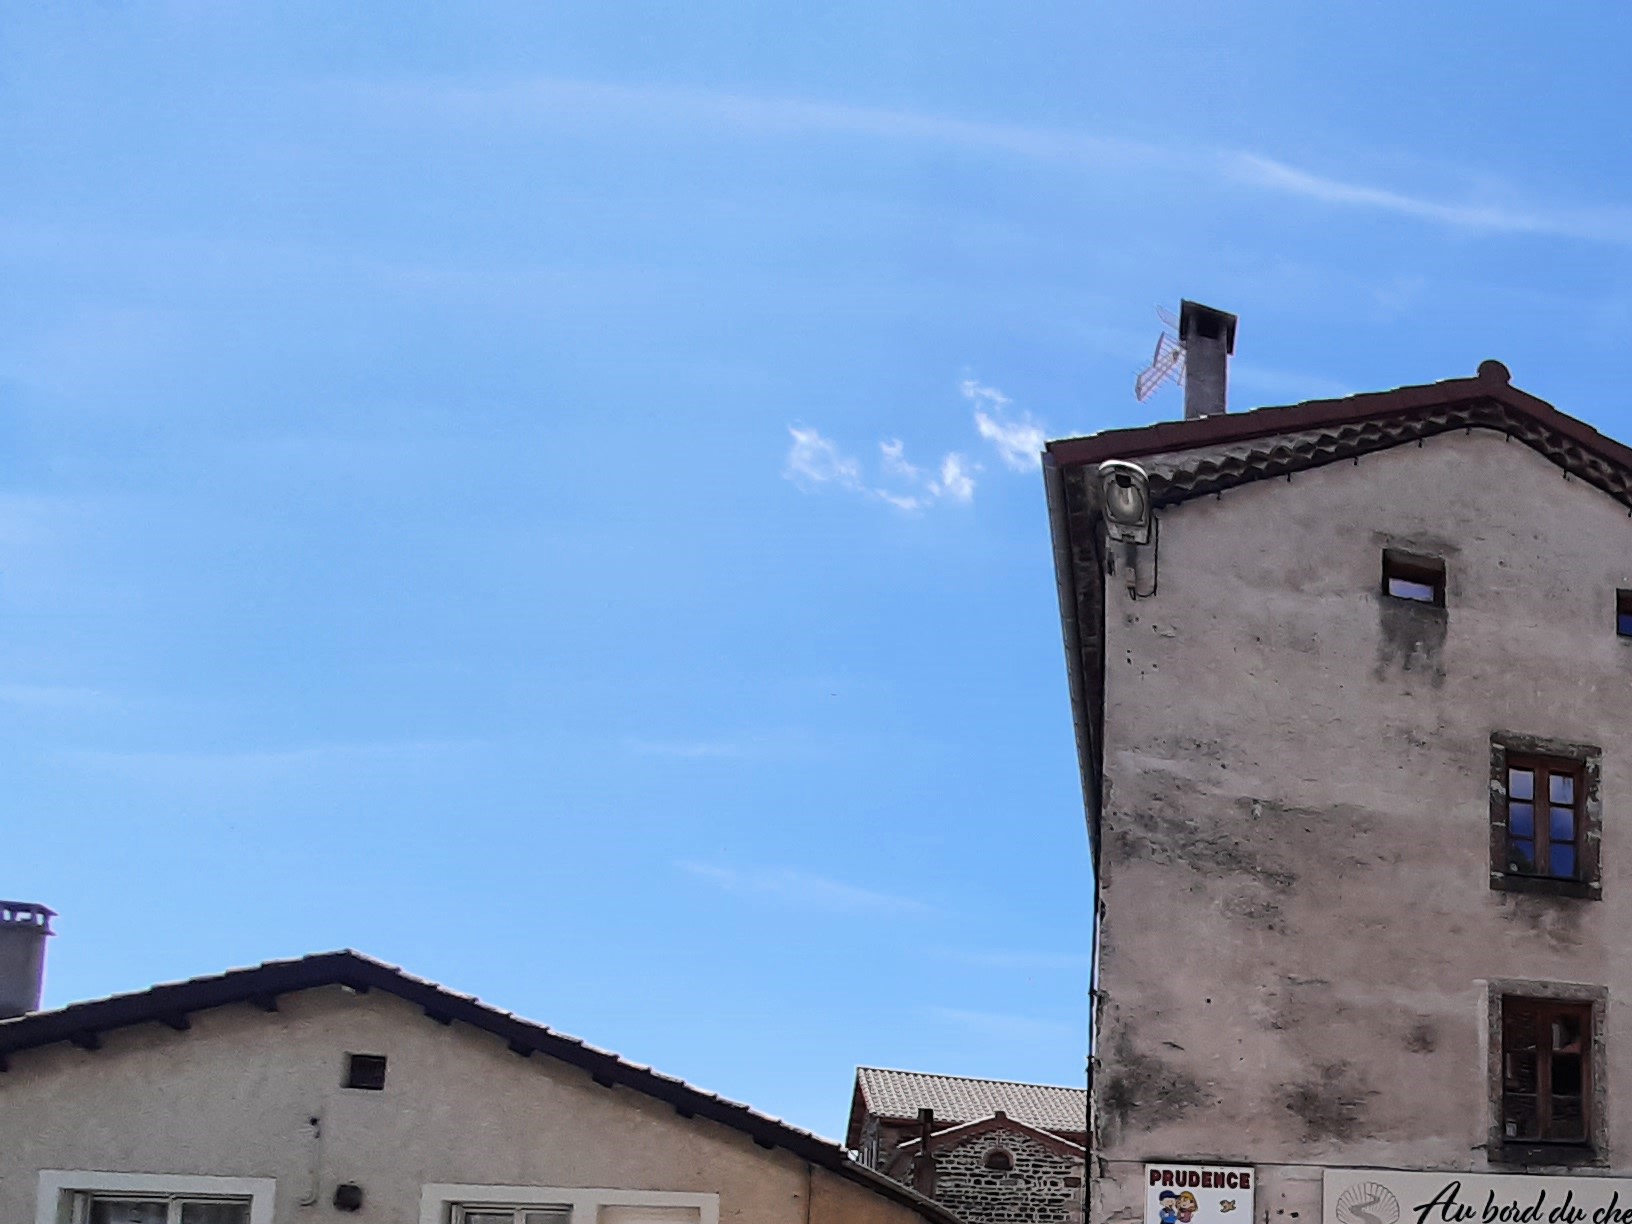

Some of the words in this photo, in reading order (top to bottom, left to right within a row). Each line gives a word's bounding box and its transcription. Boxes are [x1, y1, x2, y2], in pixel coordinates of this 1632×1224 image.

[1149, 1169, 1250, 1189] PRUDENCE
[1482, 1190, 1545, 1224] bord
[1549, 1190, 1587, 1224] du
